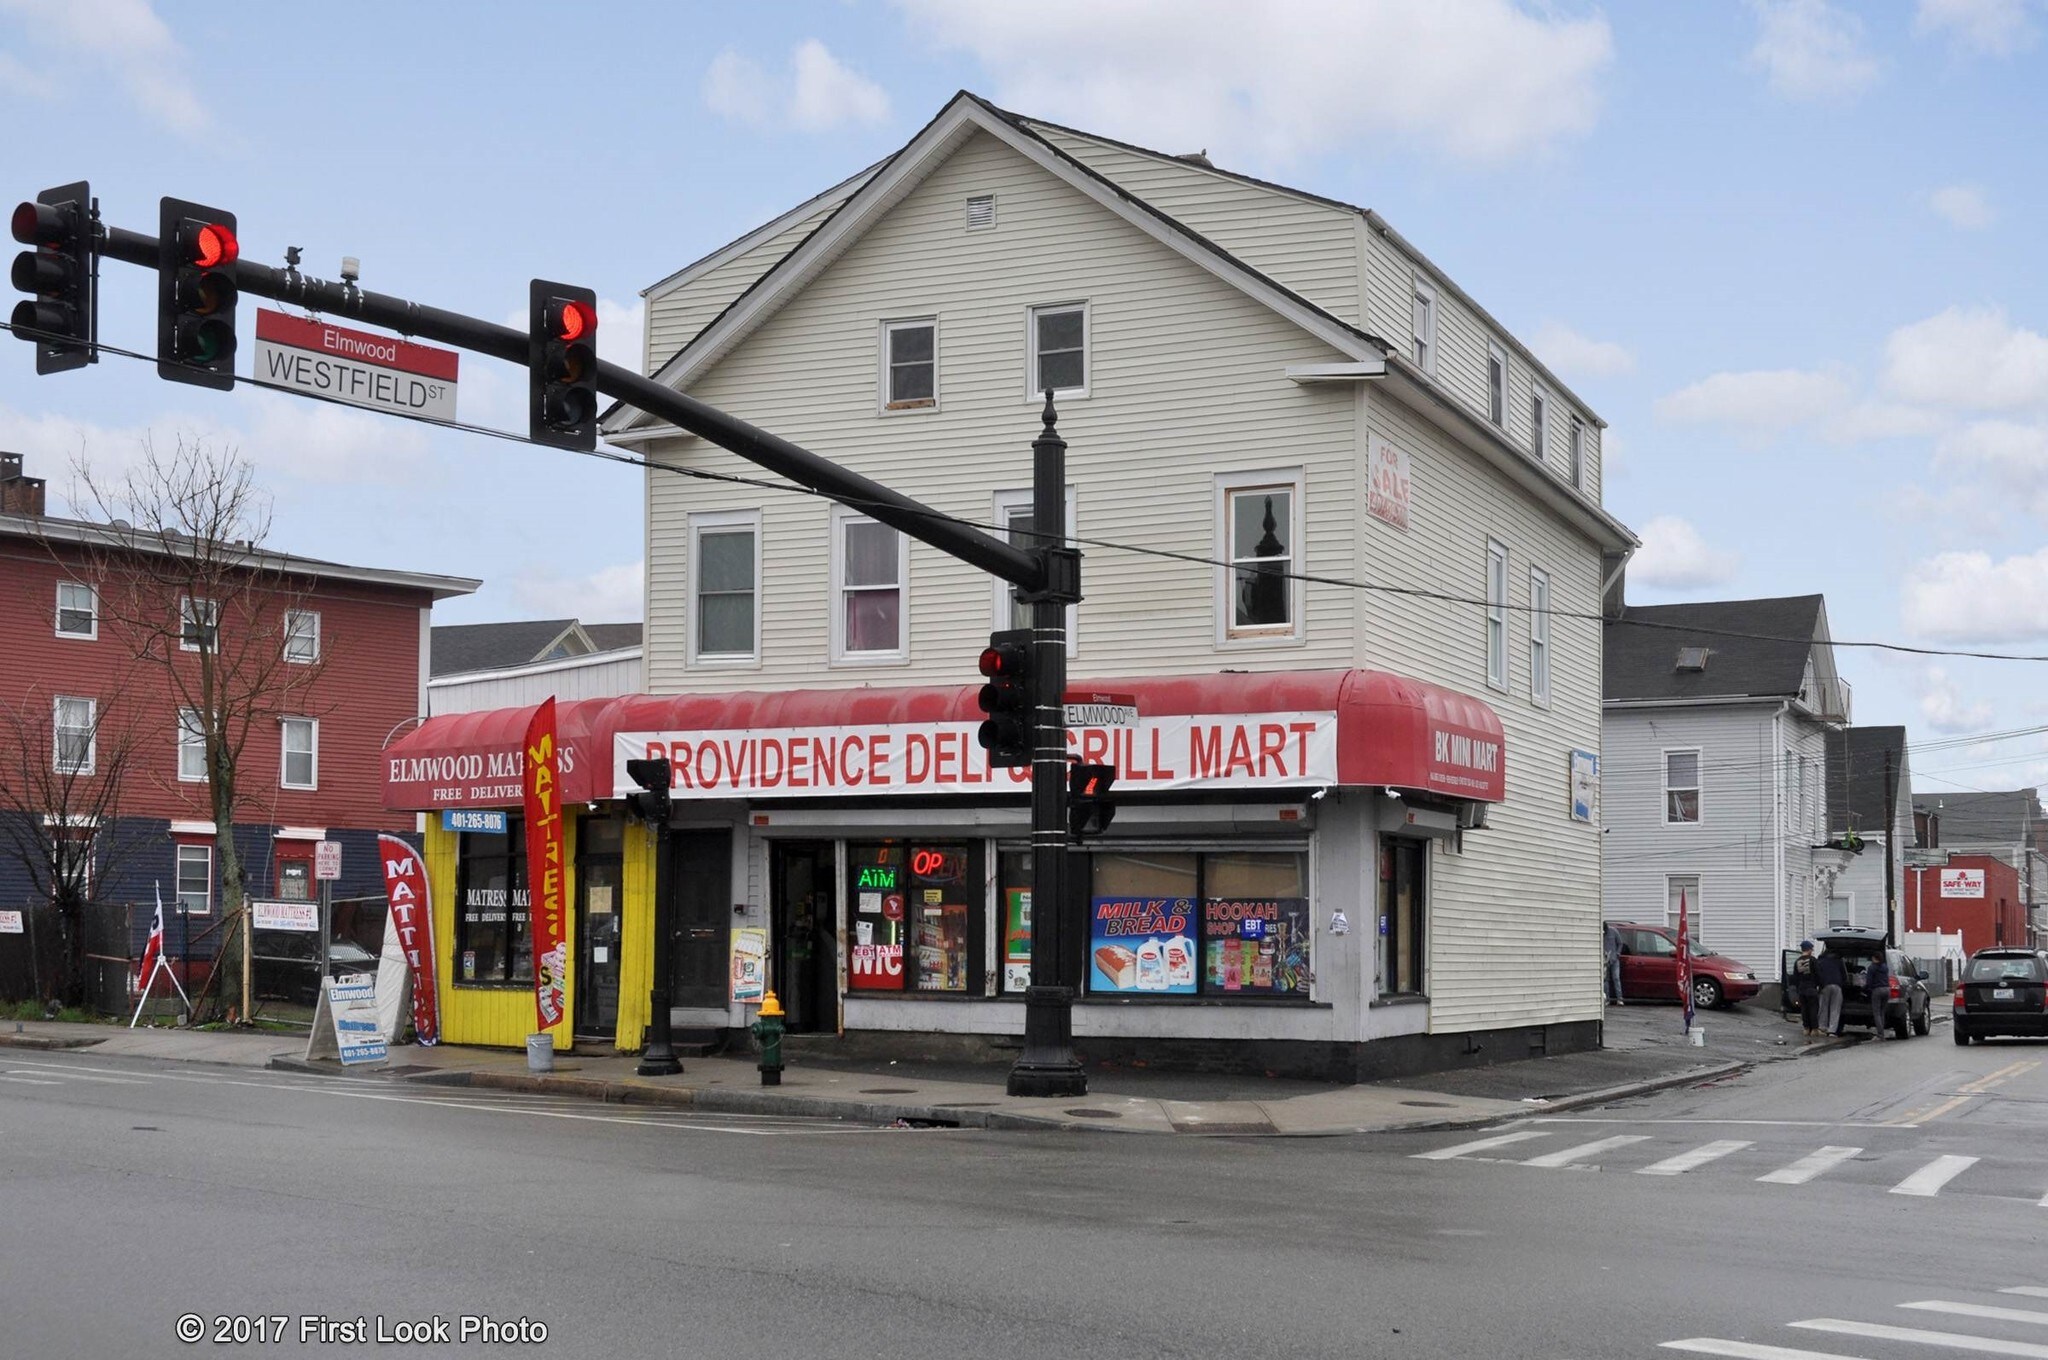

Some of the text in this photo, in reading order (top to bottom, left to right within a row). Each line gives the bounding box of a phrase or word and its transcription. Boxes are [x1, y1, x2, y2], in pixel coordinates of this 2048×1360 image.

[323, 329, 396, 362] Elmwood
[267, 349, 446, 408] WESTFIELD ST
[1380, 446, 1399, 470] FOR
[1067, 705, 1125, 725] ELMWOOD
[1189, 722, 1317, 780] MART
[1435, 730, 1498, 773] BK MINI MART
[389, 747, 575, 783] ELMWOOD MATSS
[433, 784, 524, 801] FREE DELIVER
[323, 845, 334, 853] NO
[858, 869, 895, 888] ATM
[465, 912, 479, 922] FREE
[1097, 899, 1192, 920] MILK &
[1205, 902, 1278, 921] HOOKAH
[1104, 915, 1187, 937] BREAD
[1206, 921, 1236, 936] SHOP
[1244, 919, 1262, 930] EBT
[330, 987, 375, 1001] Elmwood
